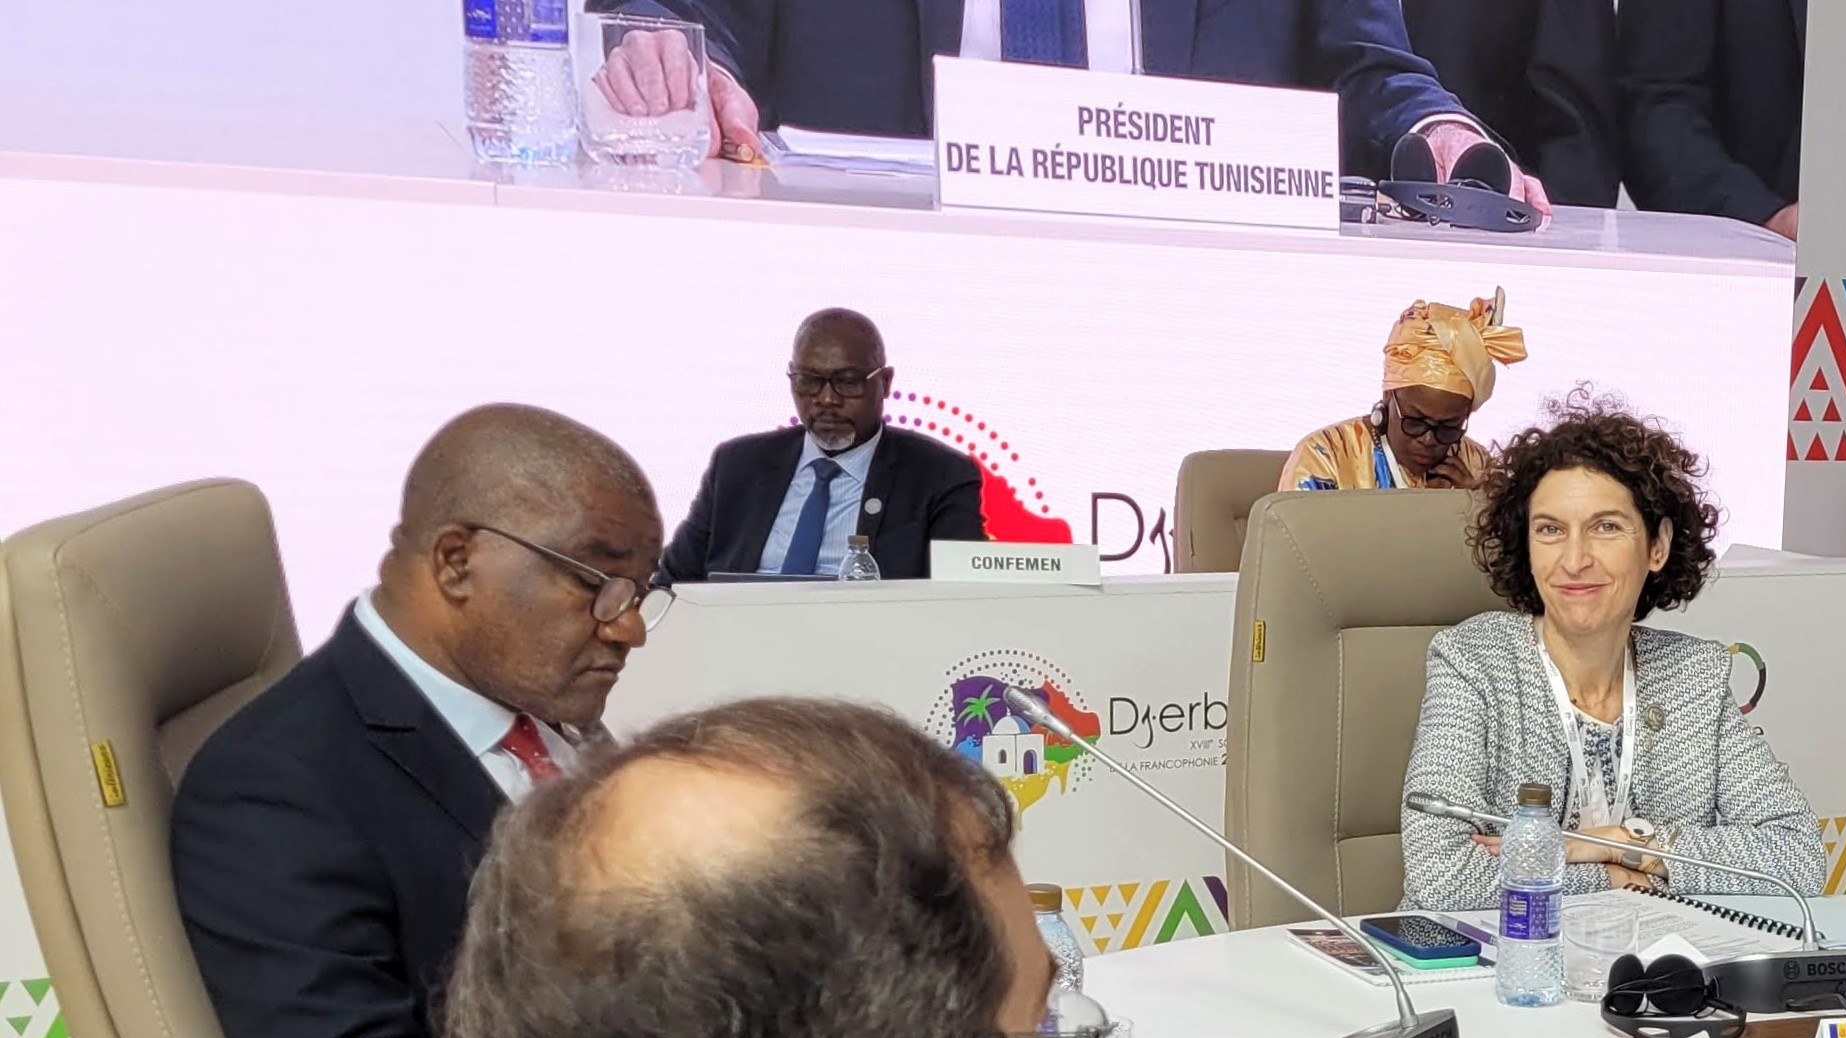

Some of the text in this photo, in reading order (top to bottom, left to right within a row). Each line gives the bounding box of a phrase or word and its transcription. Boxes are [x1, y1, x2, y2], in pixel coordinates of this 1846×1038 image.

[1077, 102, 1215, 146] PRÉSIDENT
[946, 142, 1335, 199] DE LA RÉPUBLIQUE TUNISIENNE
[971, 556, 1062, 572] CONFEMEN
[1140, 757, 1218, 771] FRANCOPHONIE
